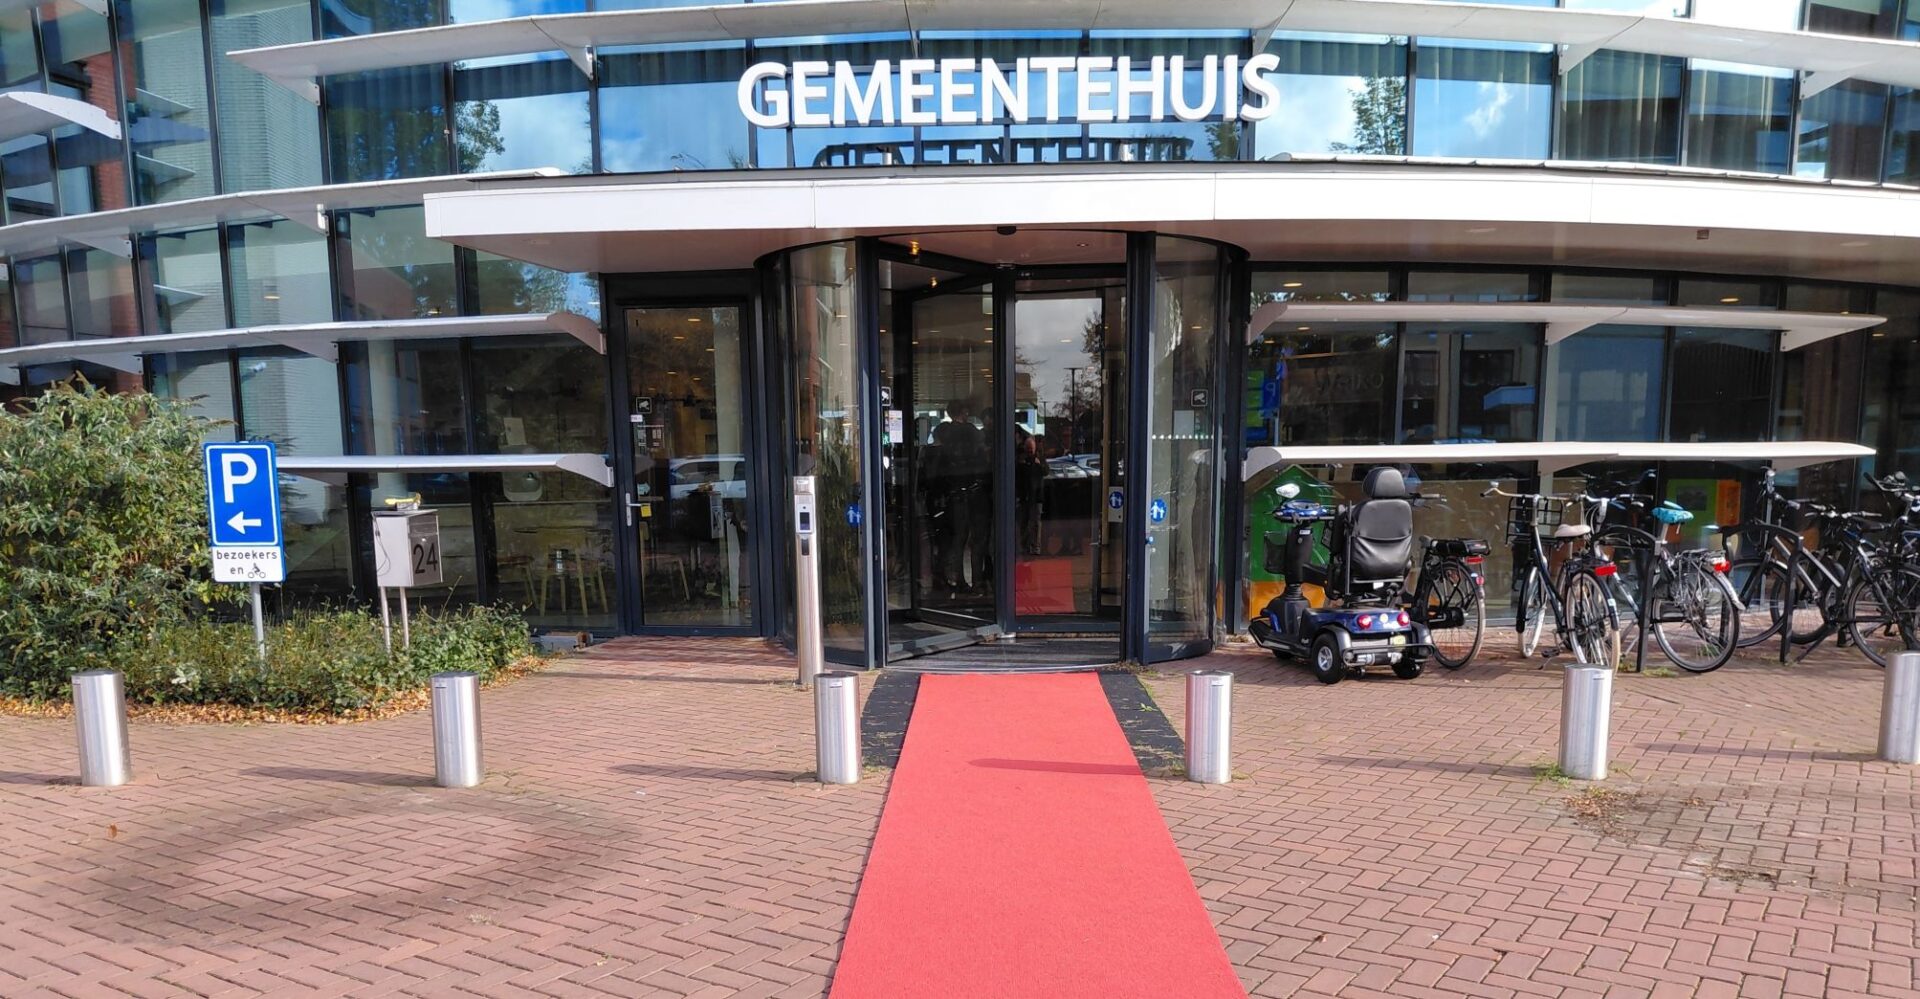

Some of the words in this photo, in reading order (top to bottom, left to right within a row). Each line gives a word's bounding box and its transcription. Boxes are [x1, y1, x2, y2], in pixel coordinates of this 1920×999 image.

[738, 53, 1281, 128] GEMEENTEHUIS
[221, 453, 257, 503] P
[217, 550, 277, 560] bezoekers
[230, 566, 244, 575] en
[413, 543, 438, 574] 24
